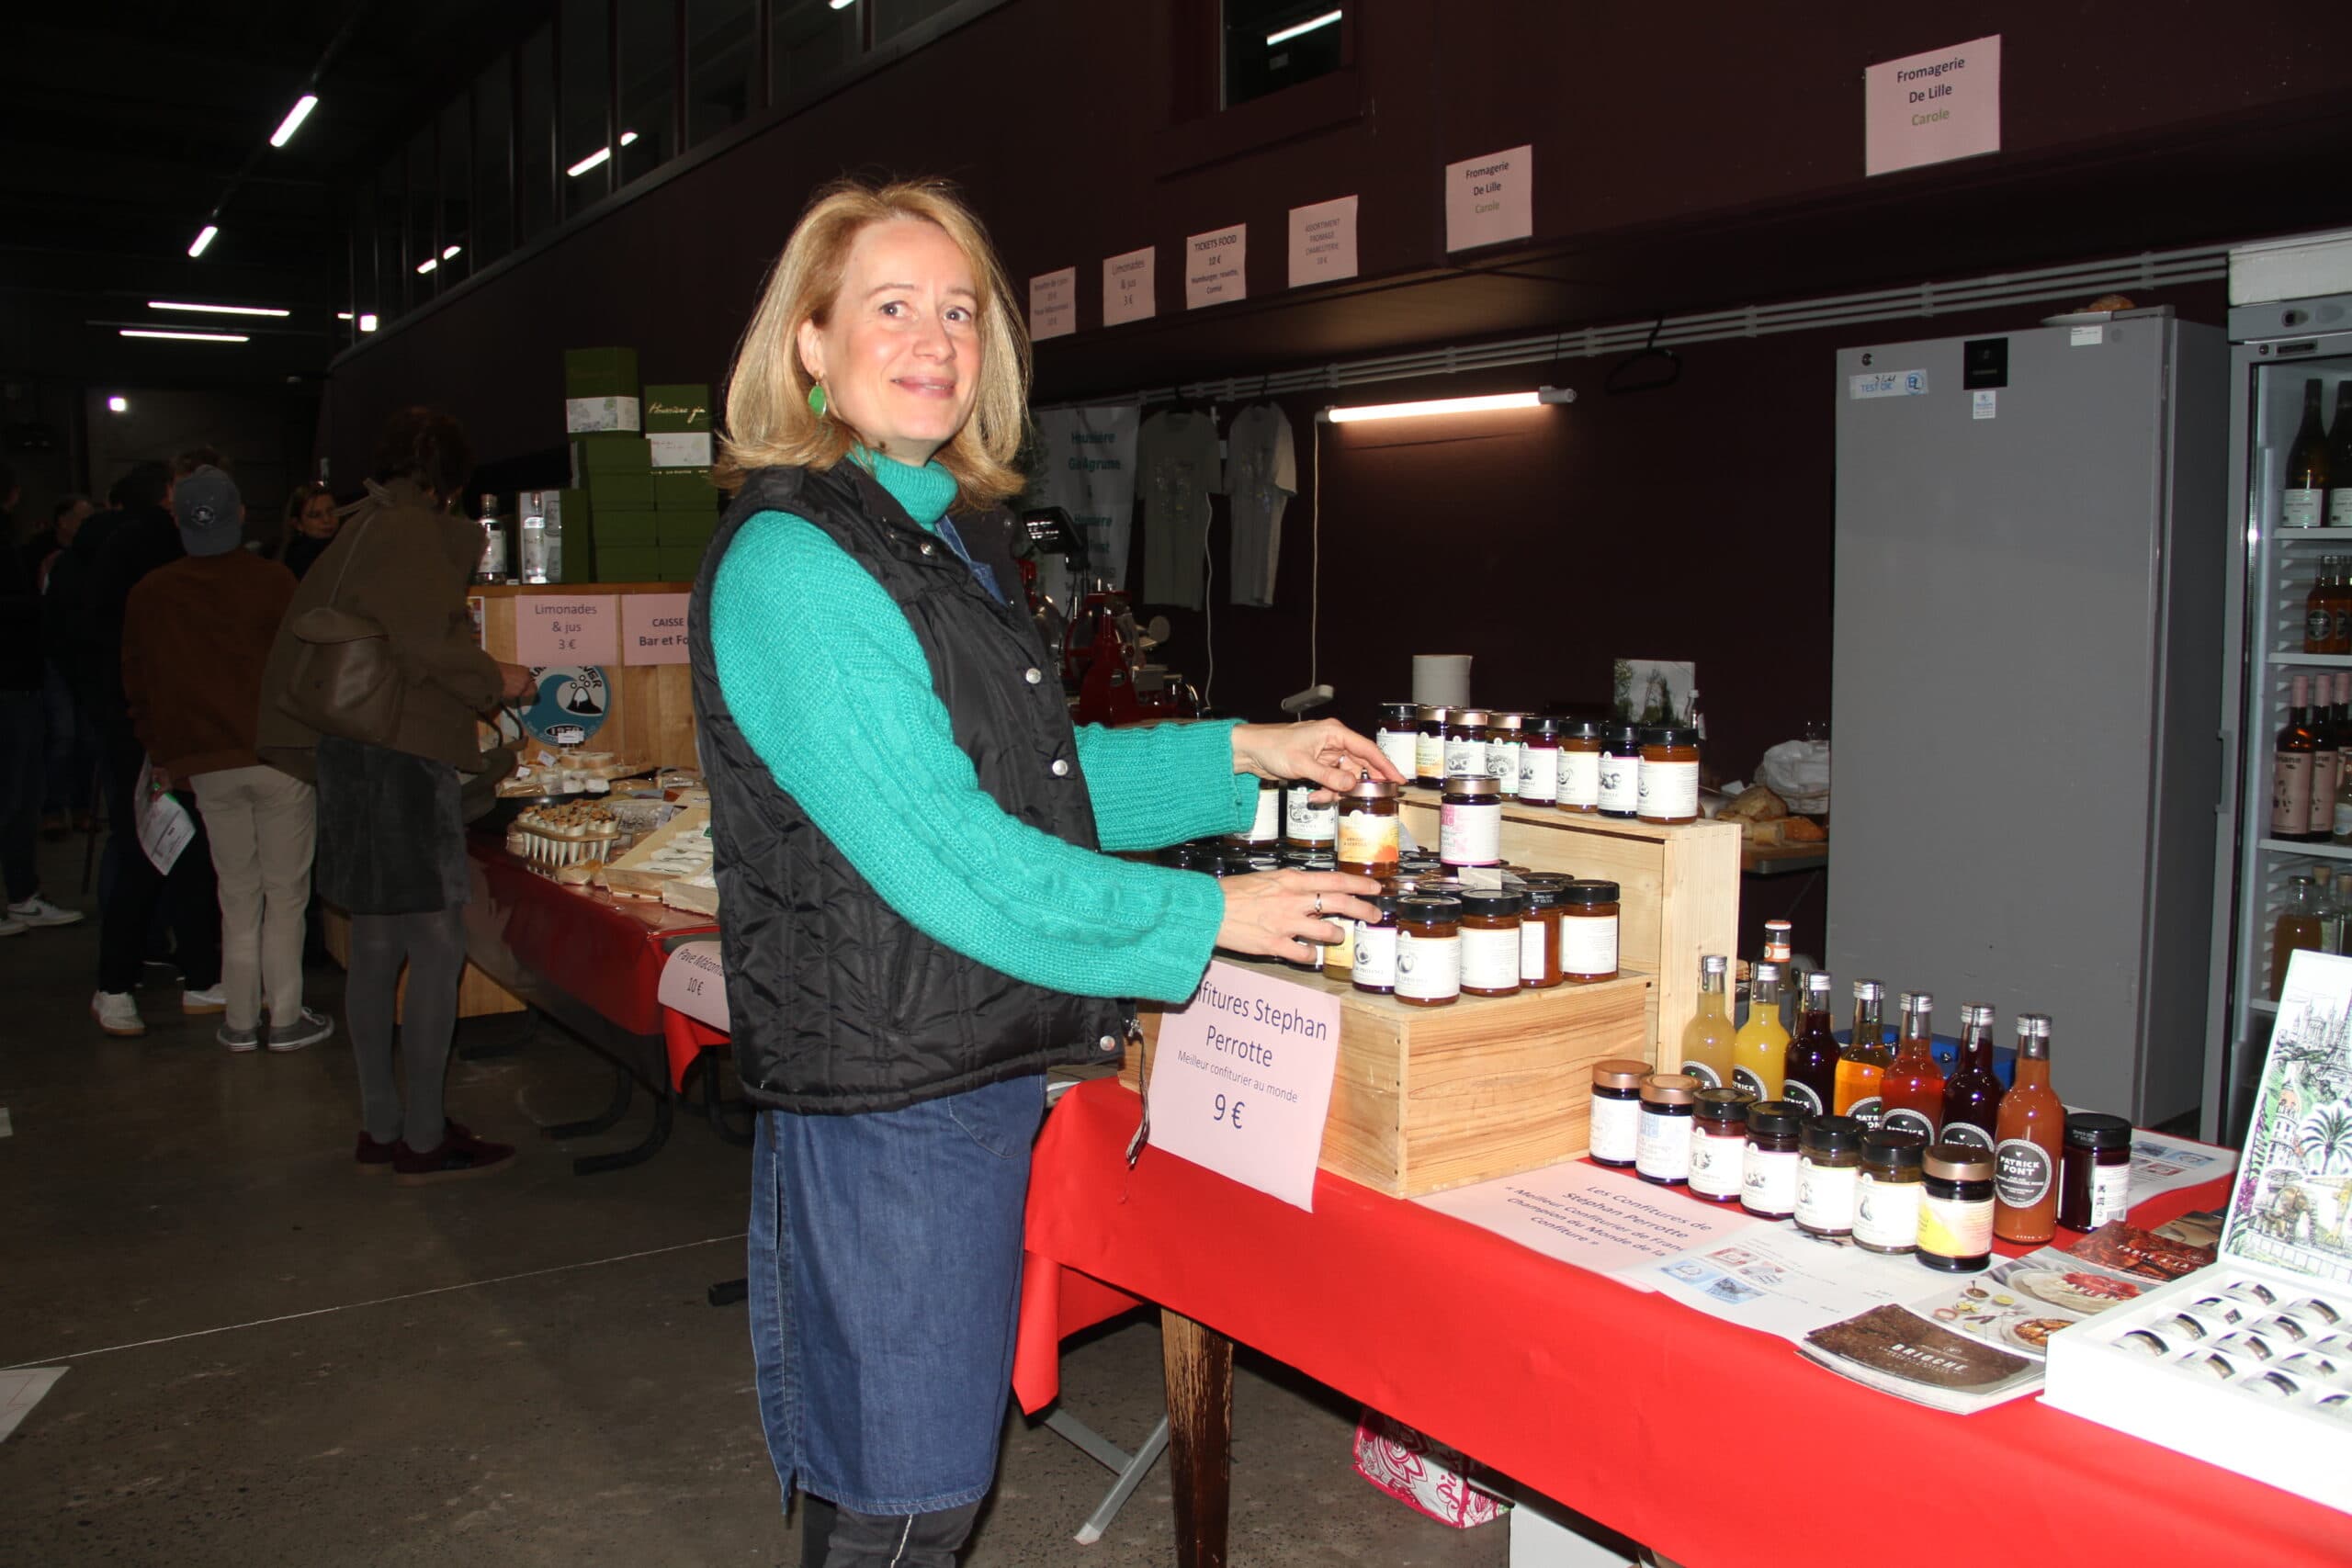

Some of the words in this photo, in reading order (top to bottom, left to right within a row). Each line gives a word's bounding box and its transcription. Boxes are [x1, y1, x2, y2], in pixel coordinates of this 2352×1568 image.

[1897, 57, 1965, 84] Fromagerie
[1909, 91, 1925, 103] De
[1928, 85, 1952, 99] Lille
[1911, 108, 1950, 126] Carole
[1465, 162, 1509, 179] Fromagerie
[1474, 186, 1484, 196] De
[1486, 182, 1501, 193] Lille
[1476, 201, 1499, 213] Carole
[1194, 239, 1217, 251] TICKETS
[1219, 235, 1237, 247] FOOD
[1860, 383, 1878, 393] TEST
[535, 604, 597, 615] Limonades
[552, 621, 561, 632] &
[565, 623, 582, 635] jus
[652, 617, 684, 627] CAISSE
[559, 639, 565, 649] 3
[569, 639, 576, 649] €
[639, 636, 658, 647] Bar
[662, 636, 673, 646] et
[676, 636, 690, 646] Fo
[687, 977, 697, 992] 10
[697, 981, 704, 996] €
[1196, 981, 1250, 1017] nfitures
[1254, 998, 1327, 1041] Stephan
[1206, 1025, 1272, 1067] Perrotte
[1178, 1050, 1208, 1071] Meilleur
[1210, 1062, 1253, 1087] confiturier
[1253, 1080, 1265, 1091] au
[1267, 1084, 1297, 1103] monde
[1214, 1093, 1227, 1122] 9
[1231, 1101, 1245, 1129] €
[1999, 1156, 2040, 1168] PATRICK
[2003, 1164, 2036, 1176] FONT
[1514, 1190, 1565, 1207] Meilleur
[1564, 1206, 1632, 1233] Confiturier
[1632, 1231, 1649, 1239] de
[1586, 1186, 1611, 1197] Les
[1612, 1195, 1689, 1224] Confitures
[1690, 1222, 1712, 1231] de
[1508, 1198, 1566, 1221] Champion
[1567, 1220, 1586, 1228] du
[1586, 1226, 1632, 1245] Monde
[1632, 1244, 1651, 1252] de
[1531, 1217, 1588, 1241] Confiture
[1624, 1214, 1689, 1238] Perrotte
[2117, 1244, 2154, 1260] TARTE
[1891, 1343, 1969, 1371] BRIOCHE
